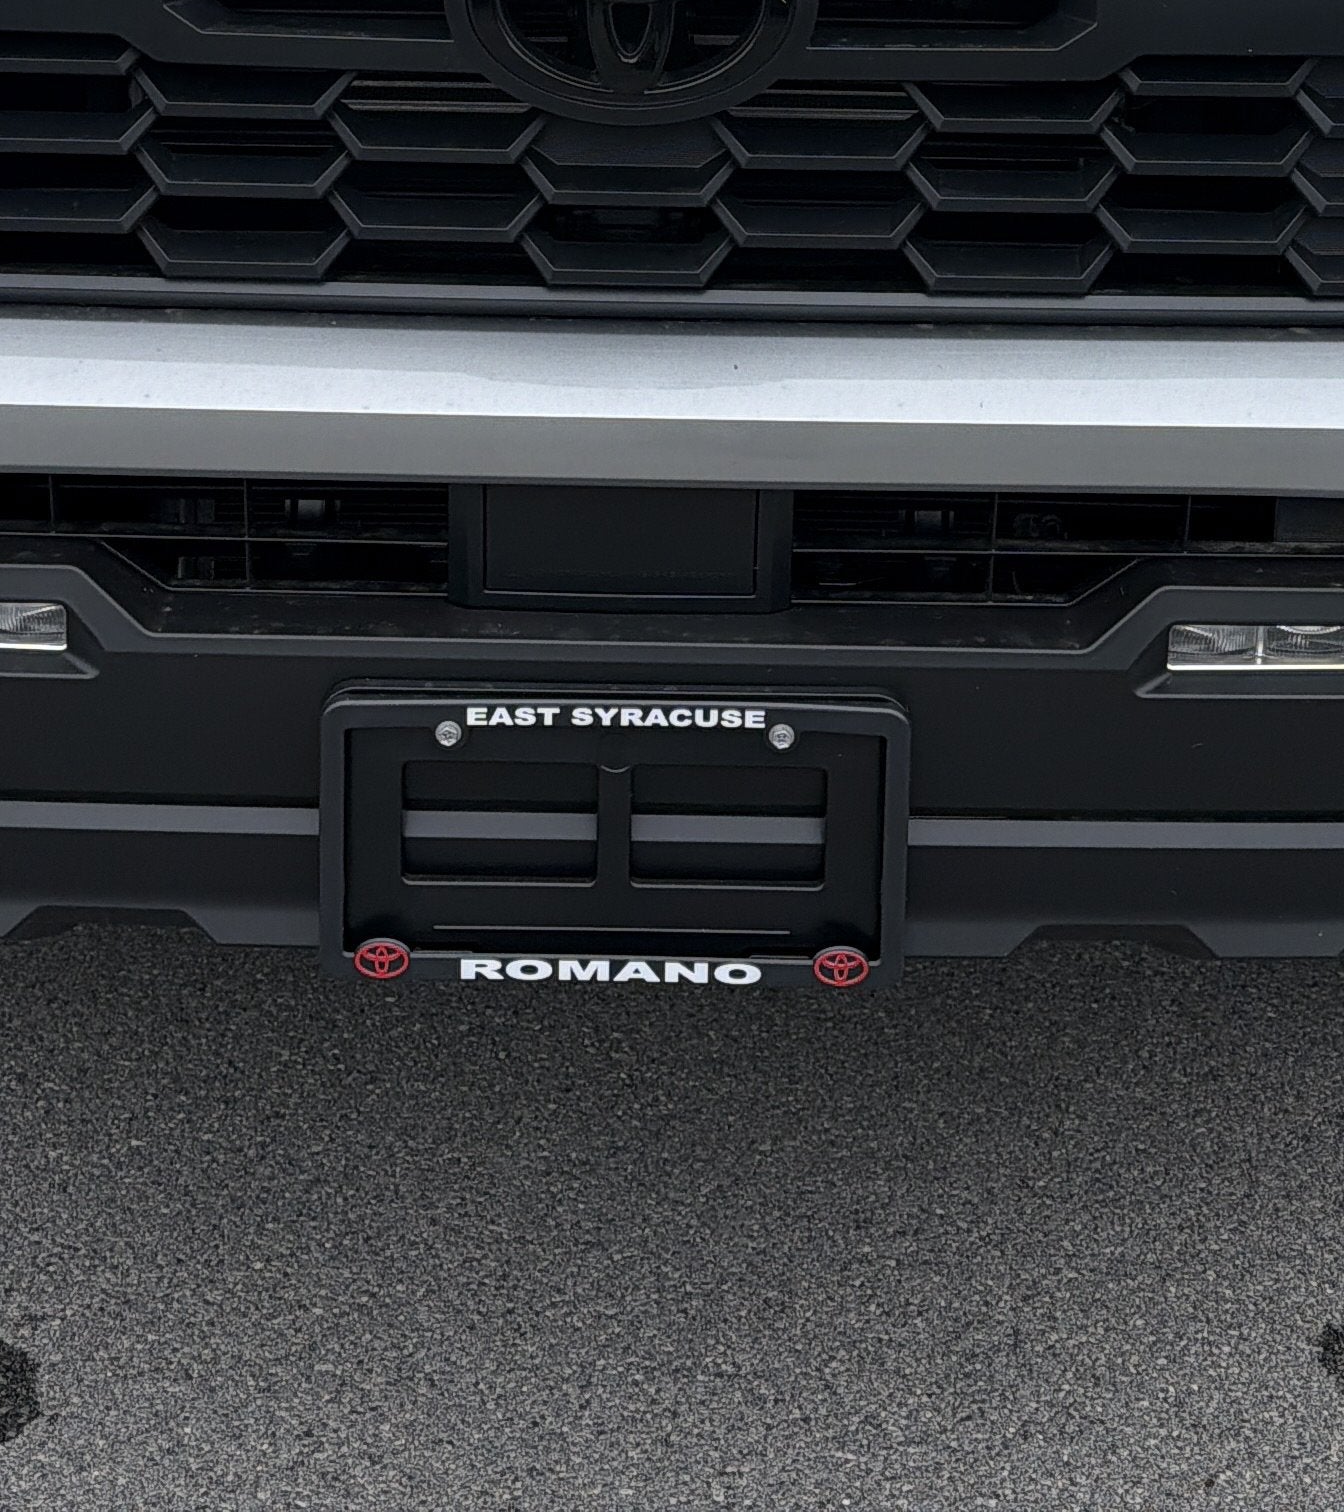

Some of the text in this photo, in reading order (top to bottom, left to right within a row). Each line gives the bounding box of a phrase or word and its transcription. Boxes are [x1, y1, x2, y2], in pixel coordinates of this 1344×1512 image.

[466, 707, 766, 728] EAST SYRACUSE
[460, 958, 762, 985] ROMANO
